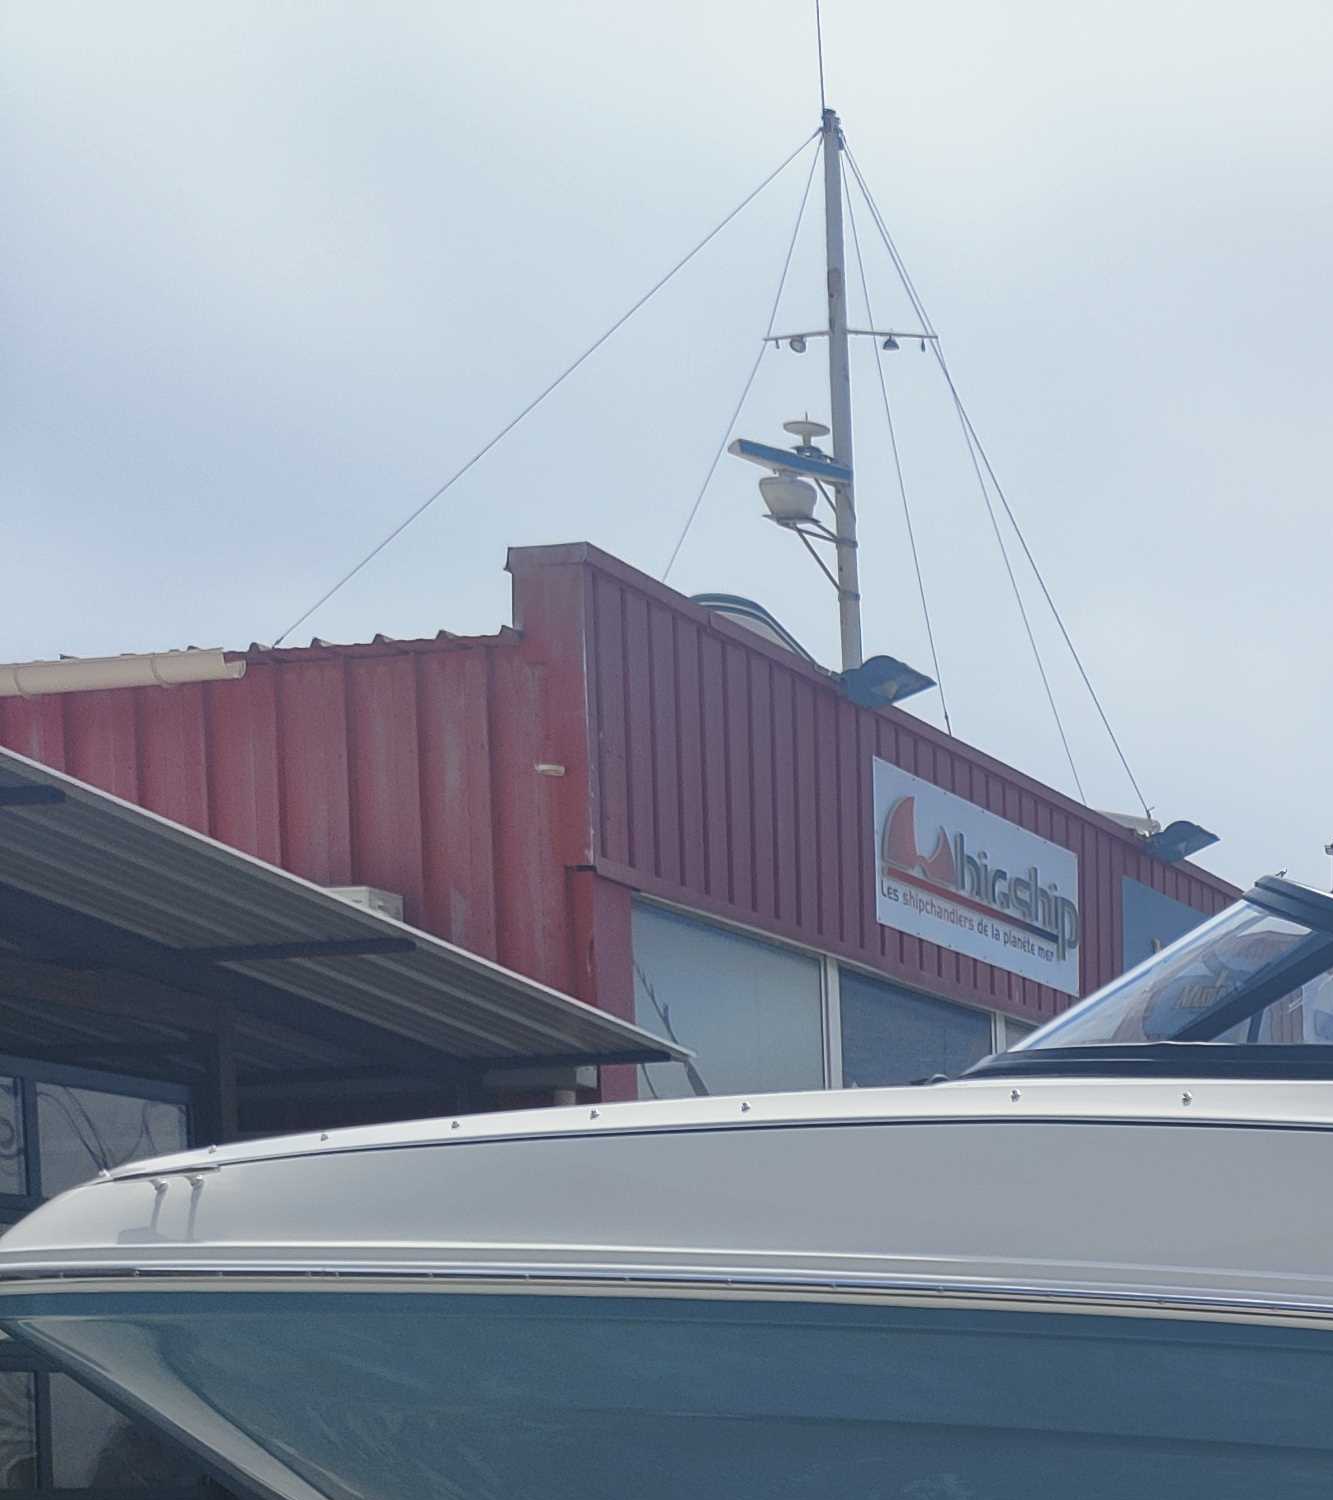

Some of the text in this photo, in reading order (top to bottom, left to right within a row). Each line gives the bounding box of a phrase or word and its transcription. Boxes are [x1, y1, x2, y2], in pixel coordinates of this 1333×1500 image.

[881, 884, 900, 902] Les
[976, 918, 989, 936] de
[991, 923, 1001, 942] la
[1037, 946, 1054, 962] mer
